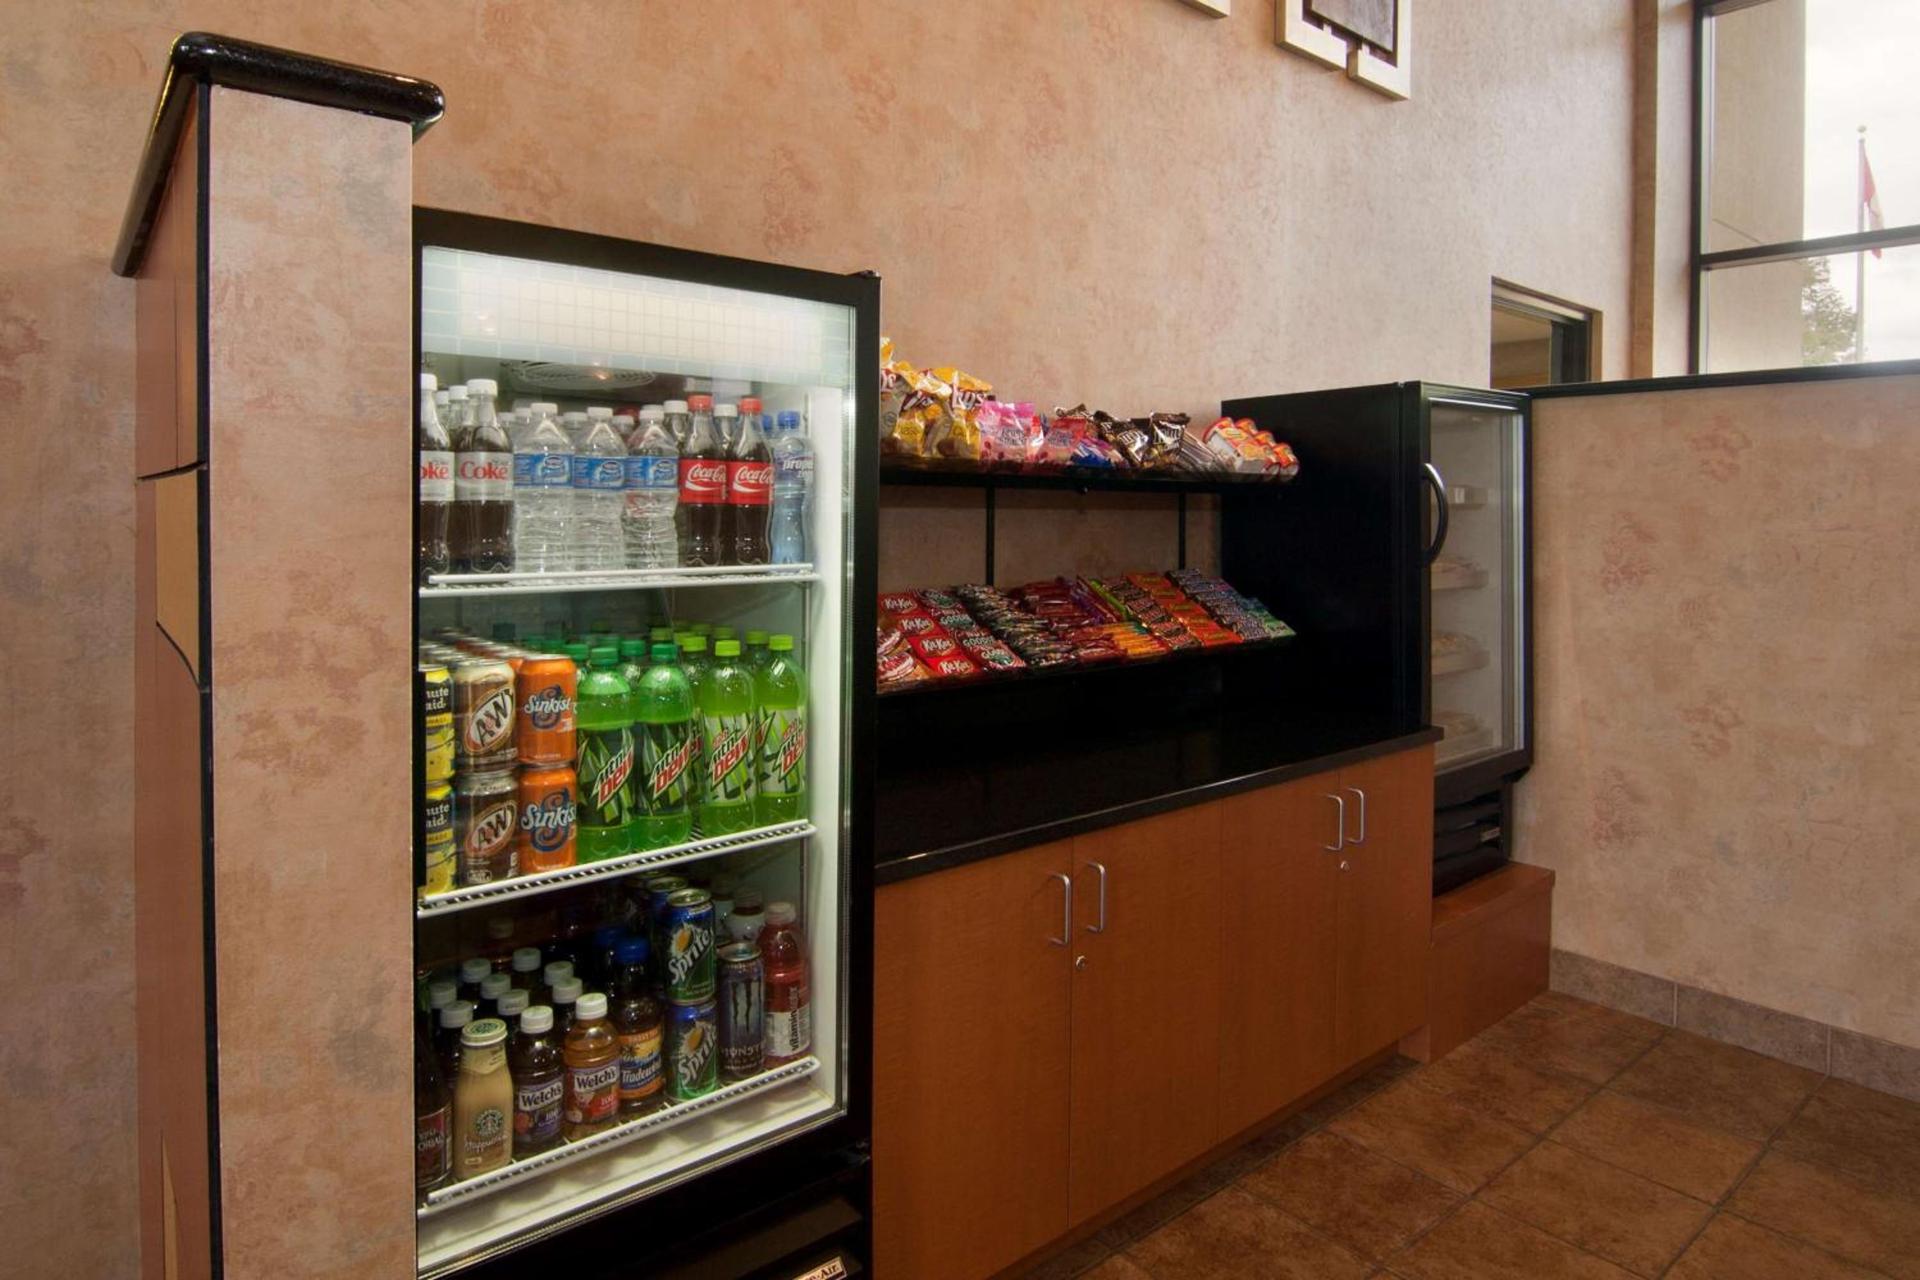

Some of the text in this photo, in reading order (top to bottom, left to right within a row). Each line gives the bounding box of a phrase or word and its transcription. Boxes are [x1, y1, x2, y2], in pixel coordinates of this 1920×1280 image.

[421, 461, 449, 480] oke
[459, 461, 508, 480] Coke
[668, 928, 710, 985] Sprite
[576, 1066, 617, 1089] Welch's
[521, 1084, 562, 1107] Welch's
